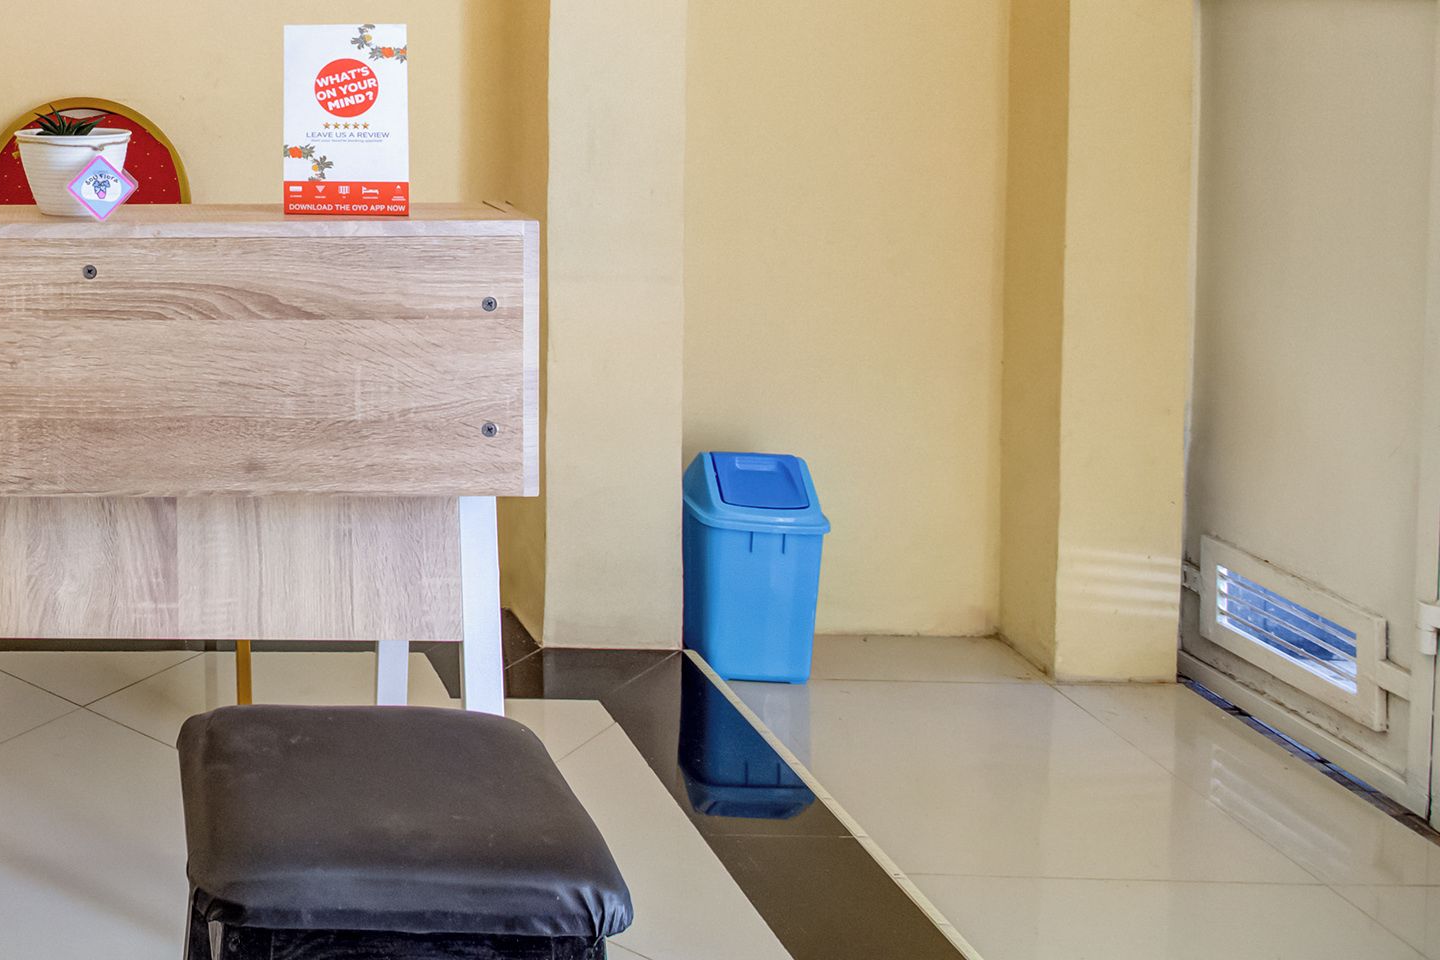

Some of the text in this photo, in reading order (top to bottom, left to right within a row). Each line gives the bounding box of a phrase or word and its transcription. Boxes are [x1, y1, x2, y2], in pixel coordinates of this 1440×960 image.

[316, 66, 370, 87] WHAT'S
[316, 78, 378, 101] ON YOUR
